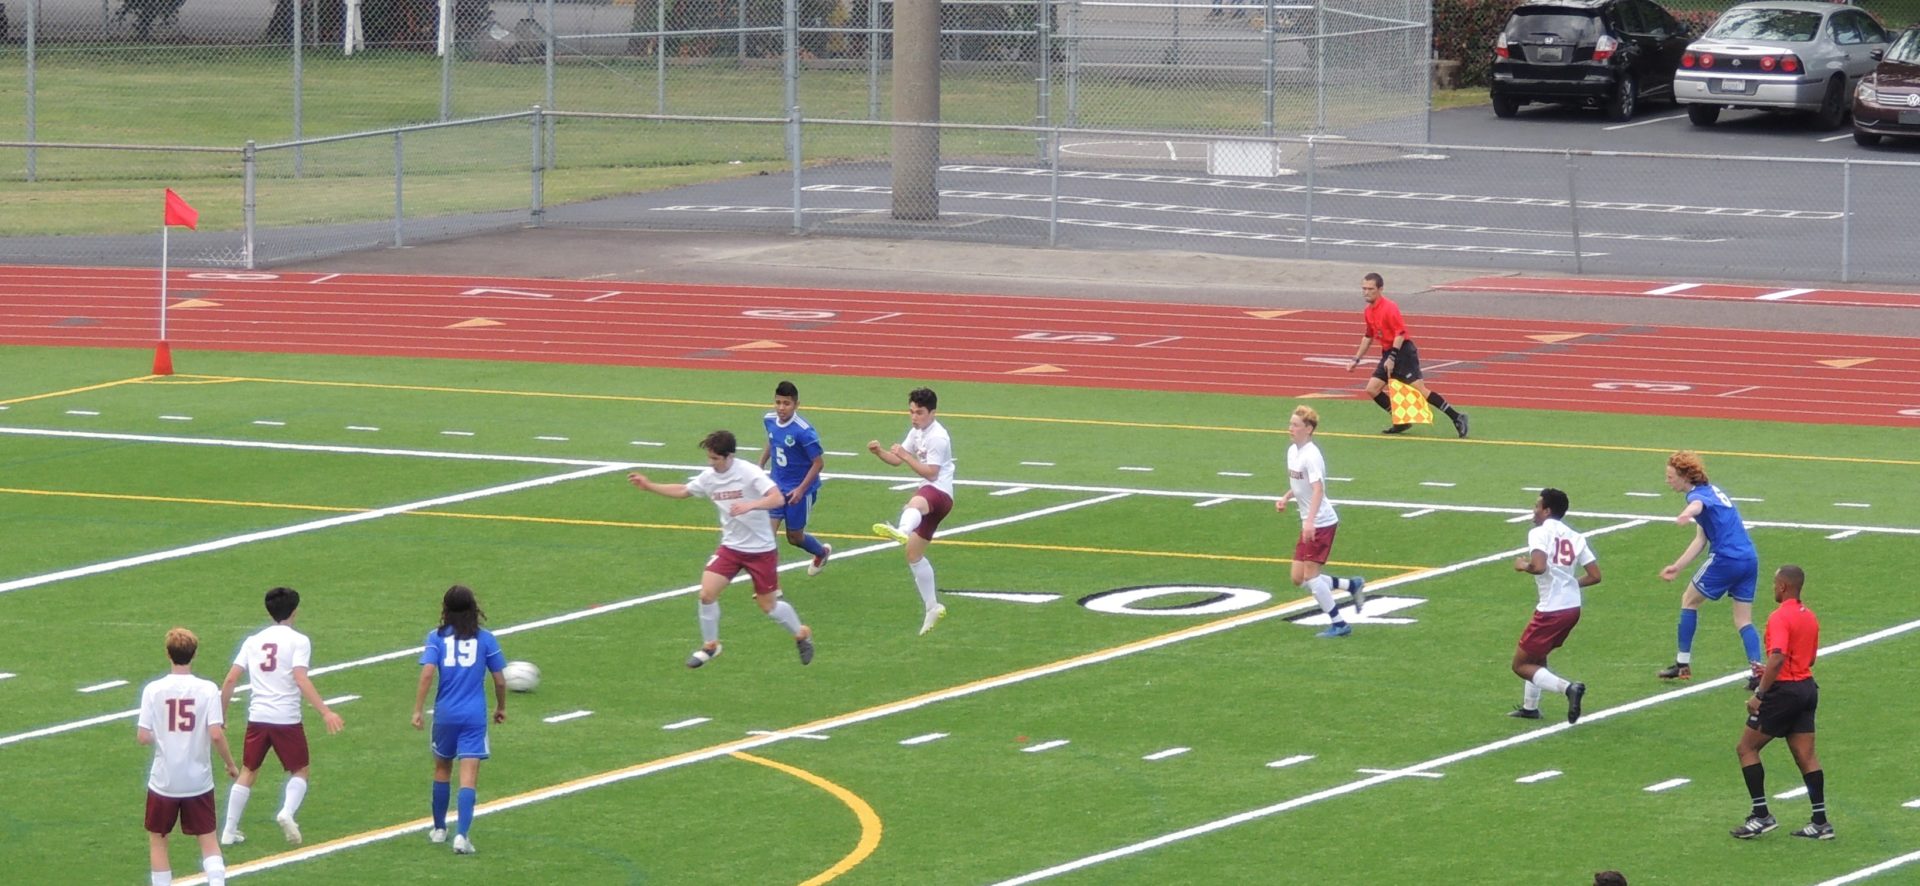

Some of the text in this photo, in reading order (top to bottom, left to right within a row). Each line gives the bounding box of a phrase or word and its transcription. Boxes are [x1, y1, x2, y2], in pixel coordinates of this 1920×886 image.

[187, 272, 279, 281] 8
[460, 288, 554, 298] 7
[741, 309, 836, 319] 6
[1013, 332, 1115, 342] 5
[1592, 381, 1692, 392] 3
[776, 447, 788, 467] 5
[1552, 537, 1576, 566] 19
[260, 643, 278, 672] 3
[443, 635, 478, 667] 19
[165, 698, 196, 732] 15
